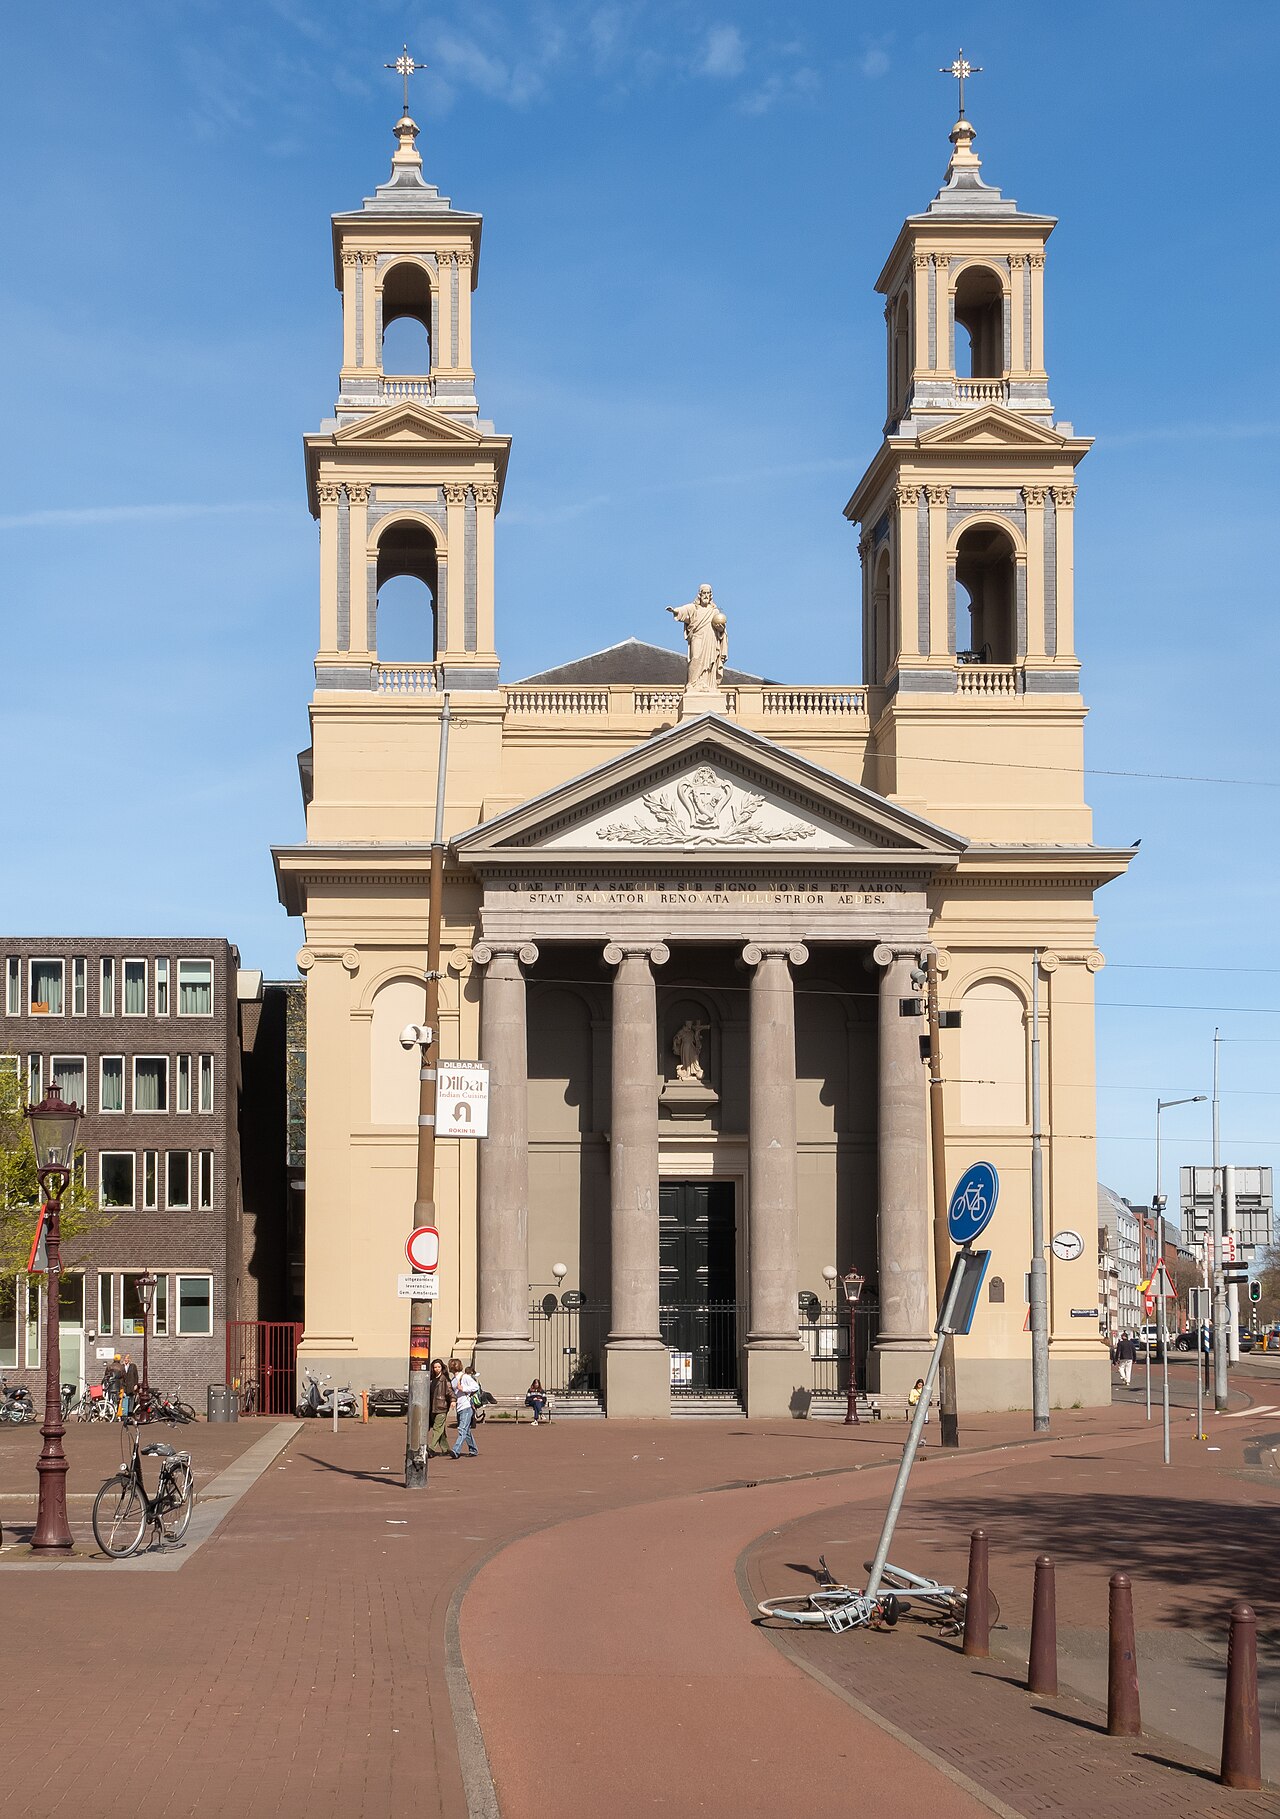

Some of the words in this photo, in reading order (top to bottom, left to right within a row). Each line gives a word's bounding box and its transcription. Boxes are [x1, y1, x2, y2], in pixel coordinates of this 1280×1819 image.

[508, 882, 543, 892] QUAE
[554, 883, 587, 891] FUIT
[592, 883, 600, 891] A
[609, 882, 665, 891] SAECLIS
[677, 883, 703, 891] SUB
[714, 883, 757, 891] SIGNO
[830, 884, 850, 892] ET
[858, 884, 907, 894] AARON,
[529, 894, 564, 903] STAT
[576, 894, 649, 903] SALVATORI
[661, 894, 730, 903] RENOVATA
[741, 894, 824, 904] ILLUSTRIOR
[838, 894, 885, 904] AEDES.
[440, 1076, 488, 1091] Dilbar
